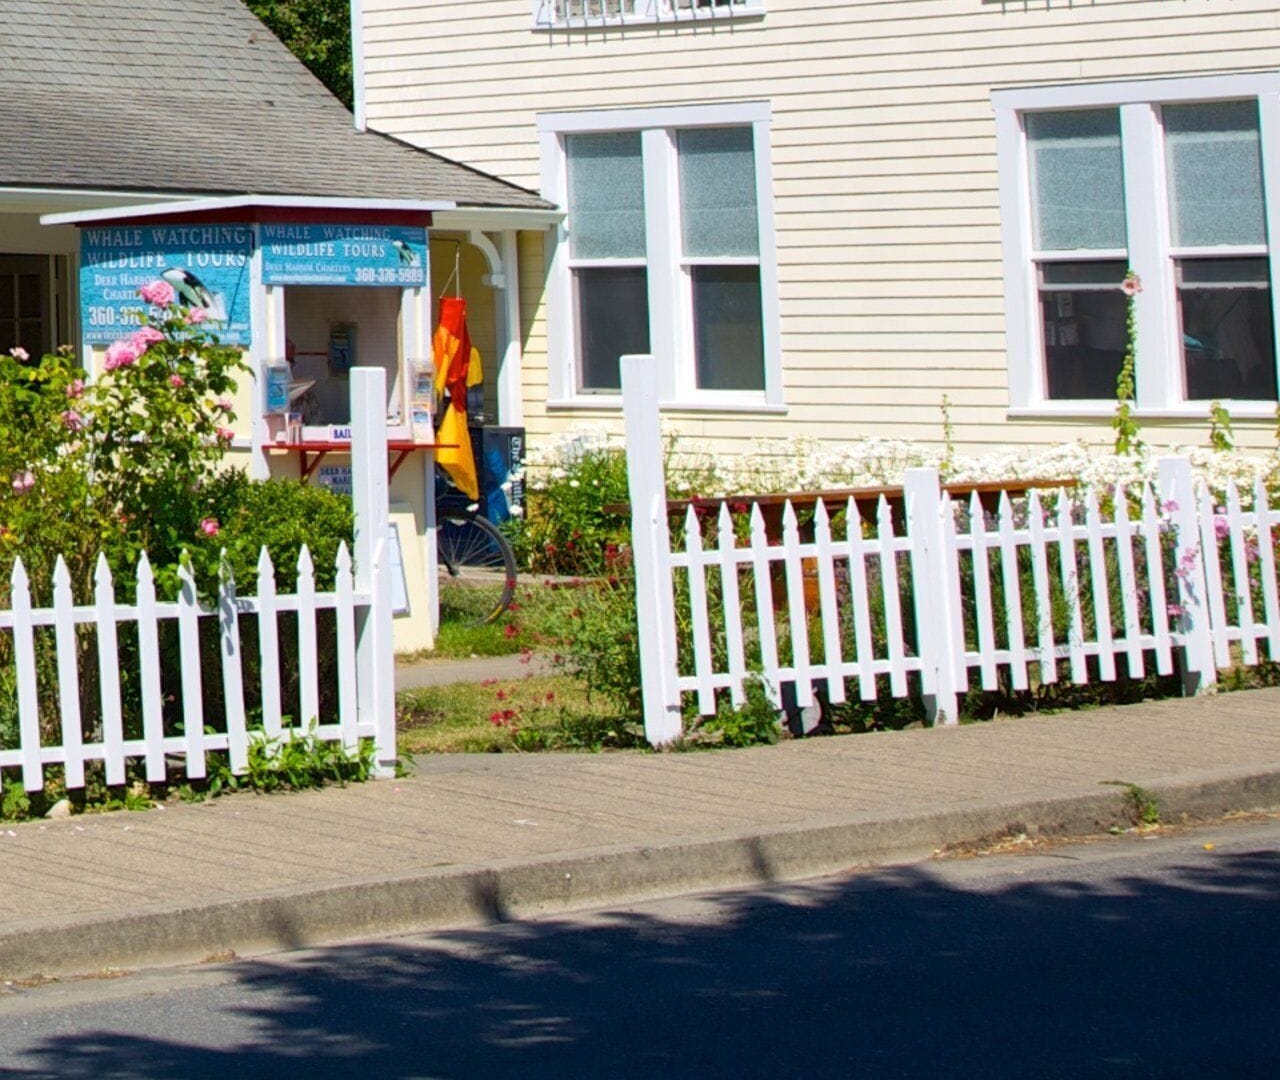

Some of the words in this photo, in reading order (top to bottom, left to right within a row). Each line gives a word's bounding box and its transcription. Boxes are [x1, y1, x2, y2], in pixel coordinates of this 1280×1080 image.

[87, 229, 143, 247] WHALE
[152, 227, 246, 246] WATCHING
[264, 226, 311, 239] WHALE
[323, 227, 391, 241] WATCHING
[87, 250, 166, 269] WILDLIFE
[187, 249, 246, 267] TOURS
[271, 243, 335, 257] WILDLIFE
[343, 244, 385, 258] TOURS
[355, 267, 424, 283] 360-376-5989
[102, 288, 144, 300] CHARTE
[511, 436, 522, 461] The
[511, 463, 523, 506] Sttle
